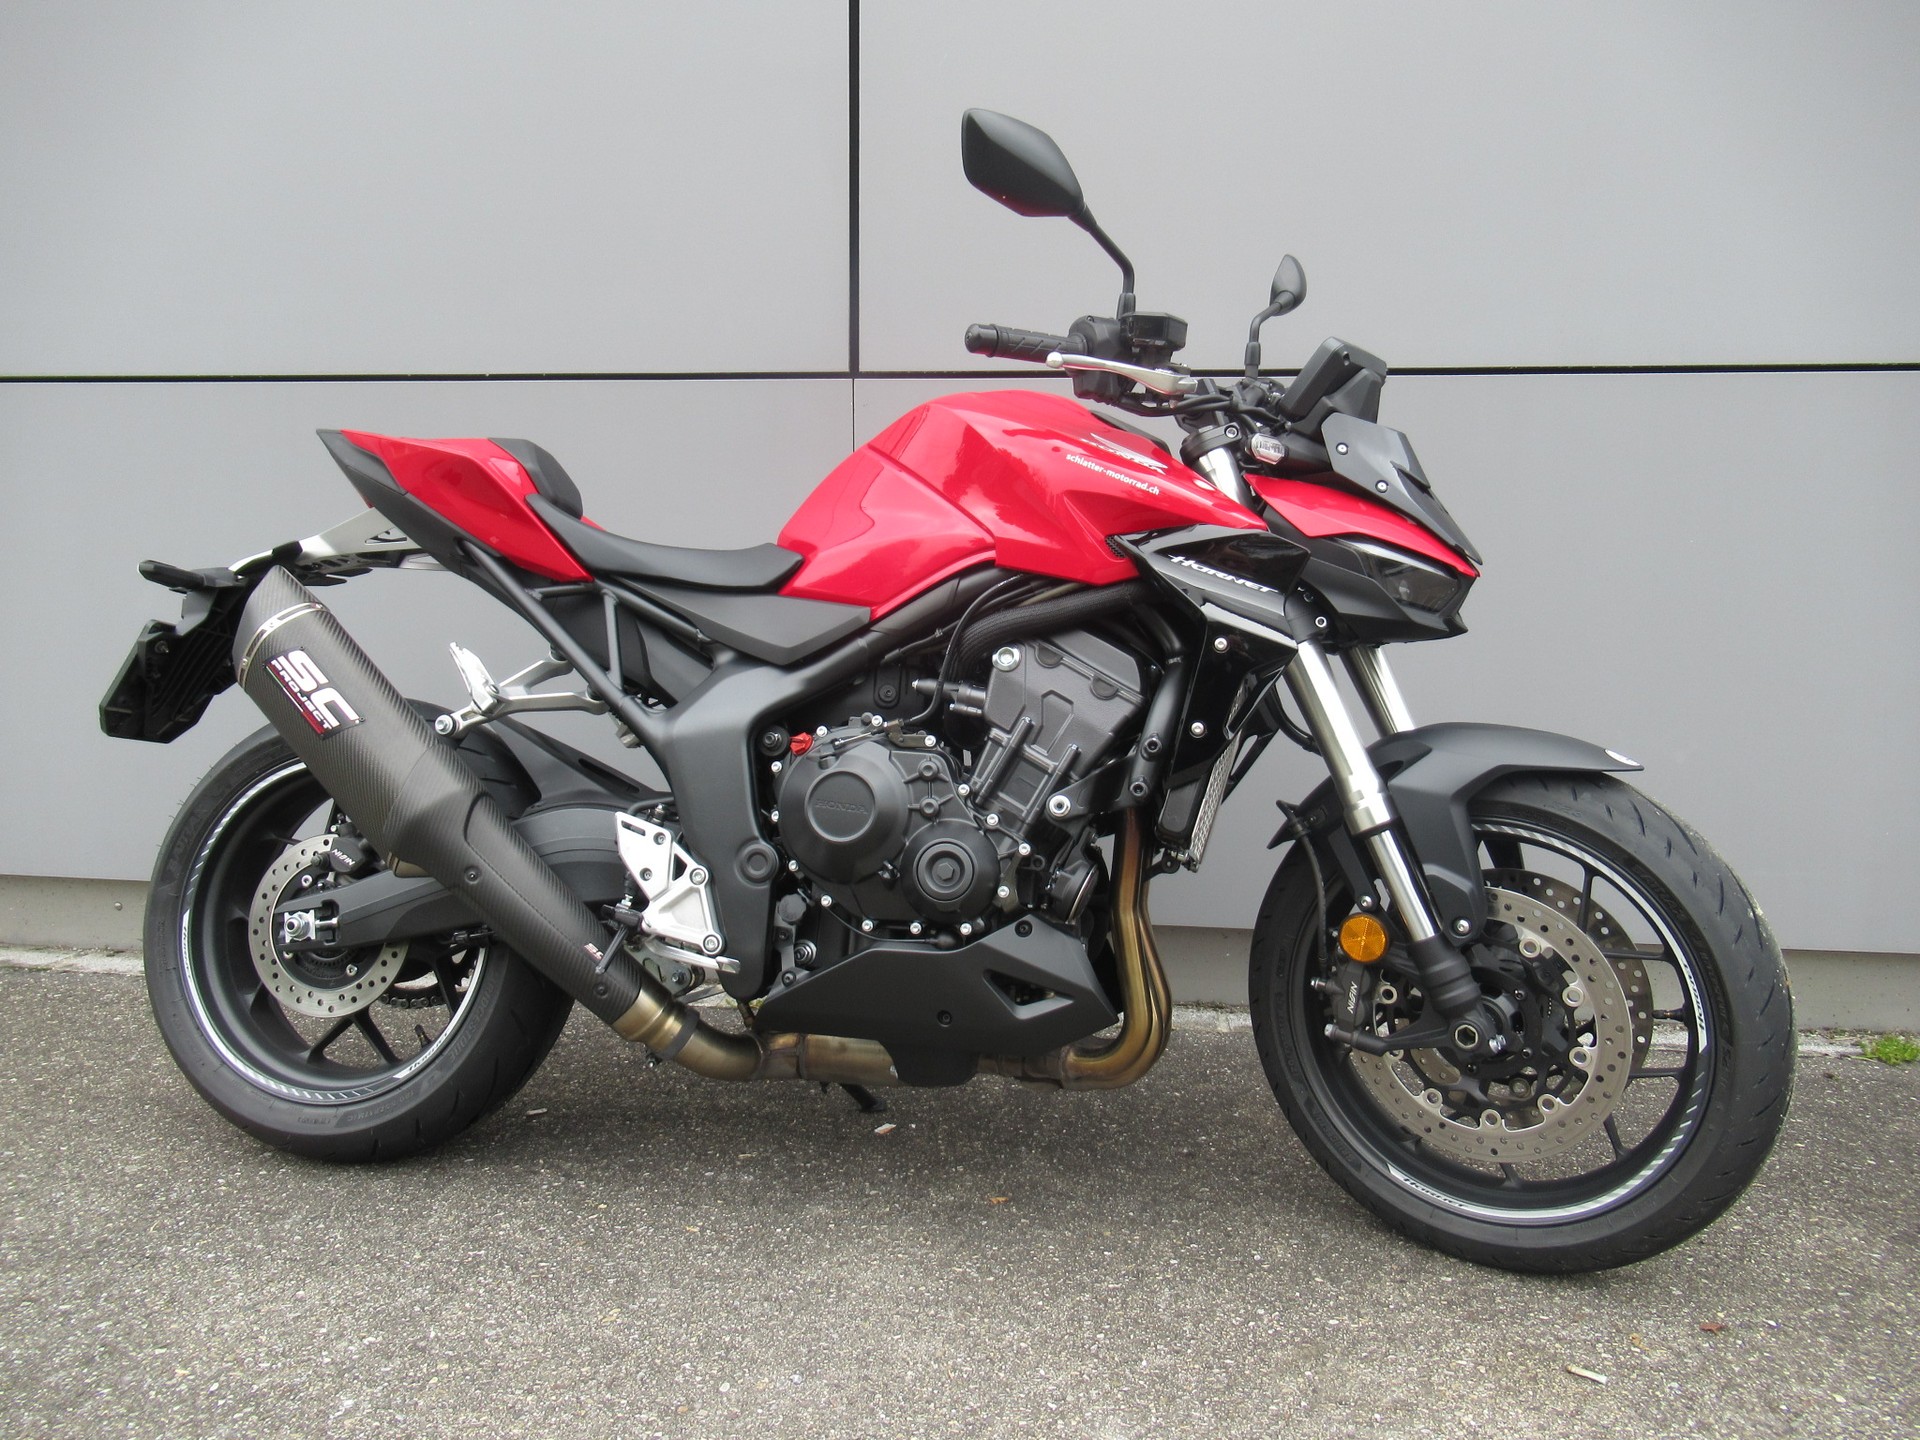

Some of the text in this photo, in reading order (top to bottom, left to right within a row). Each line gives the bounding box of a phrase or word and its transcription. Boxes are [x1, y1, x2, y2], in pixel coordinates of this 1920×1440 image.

[1065, 453, 1160, 496] schlatter-motorrad.ch
[1168, 553, 1279, 594] HORNET
[270, 658, 333, 730] PROJECT
[277, 649, 361, 728] SC
[814, 799, 869, 815] HONDA
